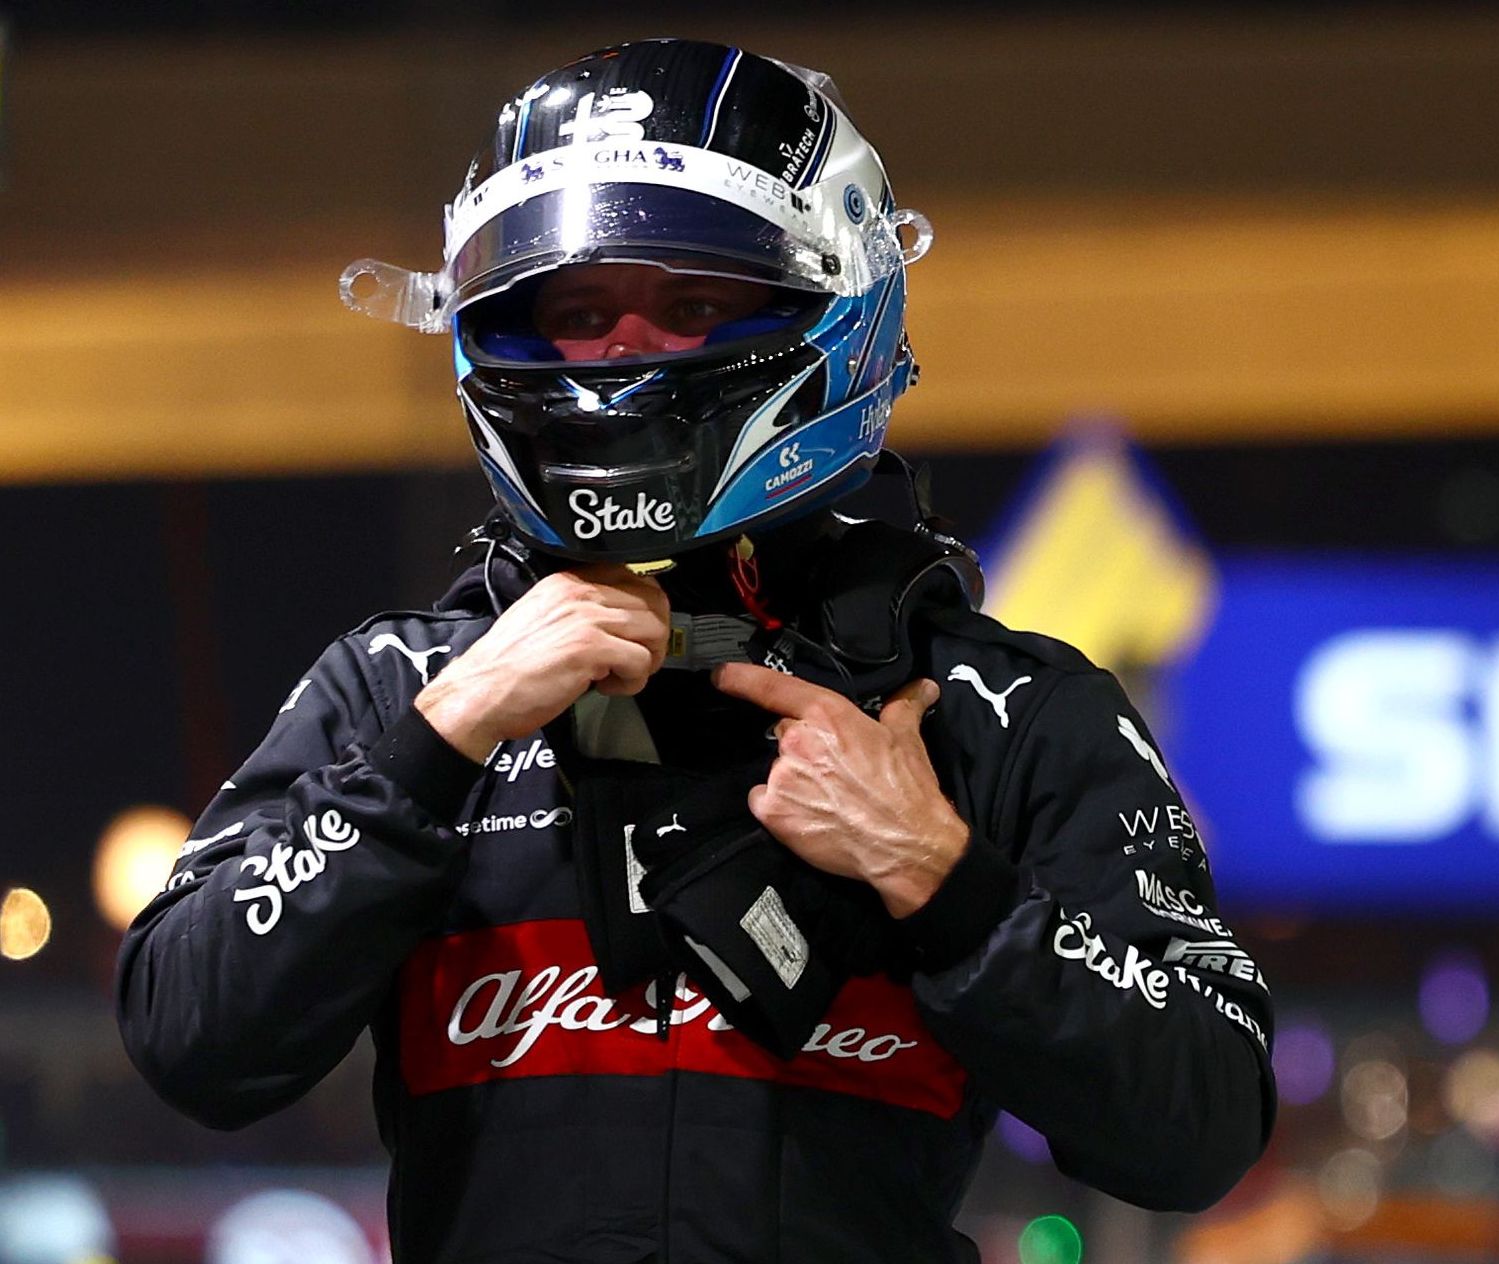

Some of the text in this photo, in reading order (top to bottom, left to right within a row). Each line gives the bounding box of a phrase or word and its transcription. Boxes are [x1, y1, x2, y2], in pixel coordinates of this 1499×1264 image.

[552, 149, 648, 171] SGHA
[727, 161, 785, 200] WEB
[782, 128, 816, 184] BRATECH
[765, 458, 814, 491] CAMOZZI
[568, 488, 676, 539] Stake
[233, 809, 360, 935] Stake
[1135, 869, 1205, 916] MASC
[1053, 907, 1169, 1009] Stake
[447, 965, 632, 1068] Alfa
